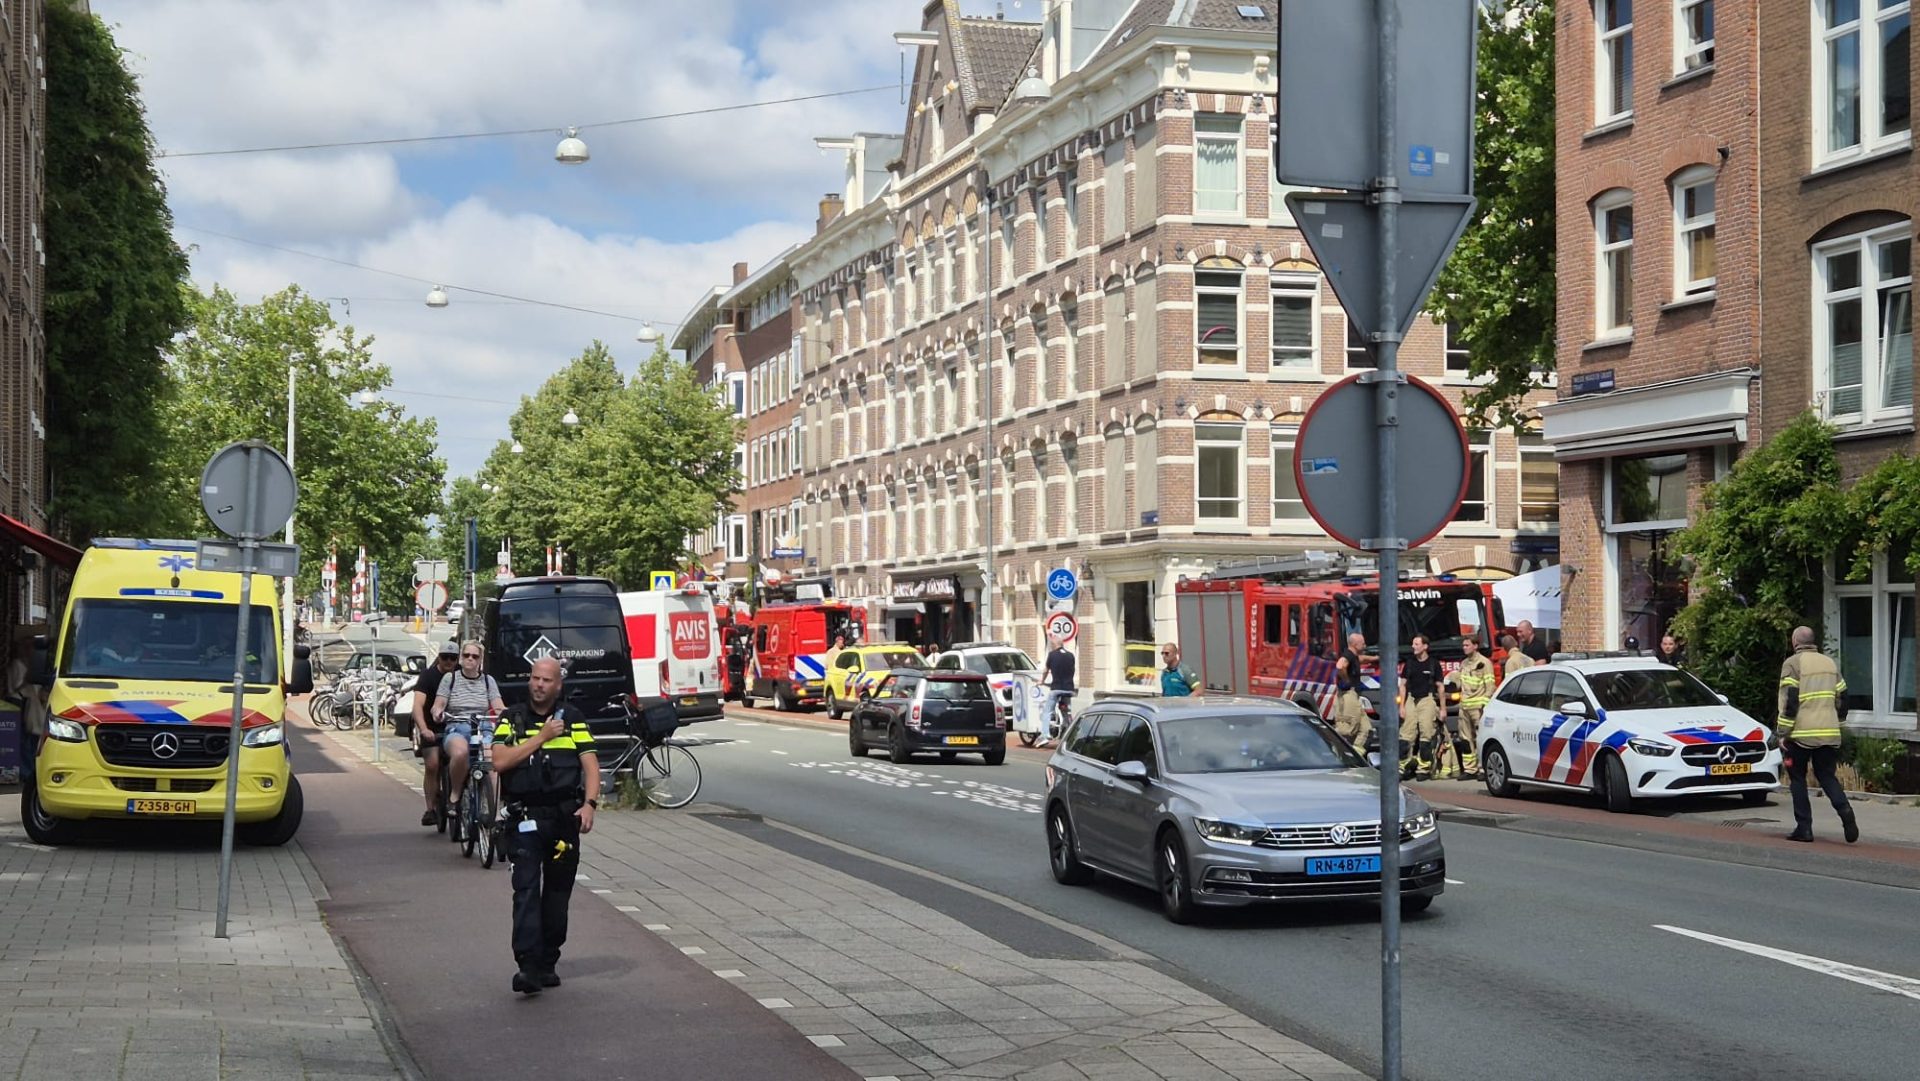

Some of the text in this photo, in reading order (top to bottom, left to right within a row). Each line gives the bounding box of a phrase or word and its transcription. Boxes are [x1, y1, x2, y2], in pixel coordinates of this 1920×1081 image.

[675, 619, 706, 641] AVIS
[1053, 622, 1072, 634] 30
[555, 649, 605, 659] VERPAKKING
[121, 691, 215, 699] AMBULANCE
[1512, 730, 1537, 743] POLITIE
[1711, 765, 1748, 774] GPK-09-B
[137, 801, 190, 812] Z-358-GH
[1315, 858, 1373, 872] RN-487-T
